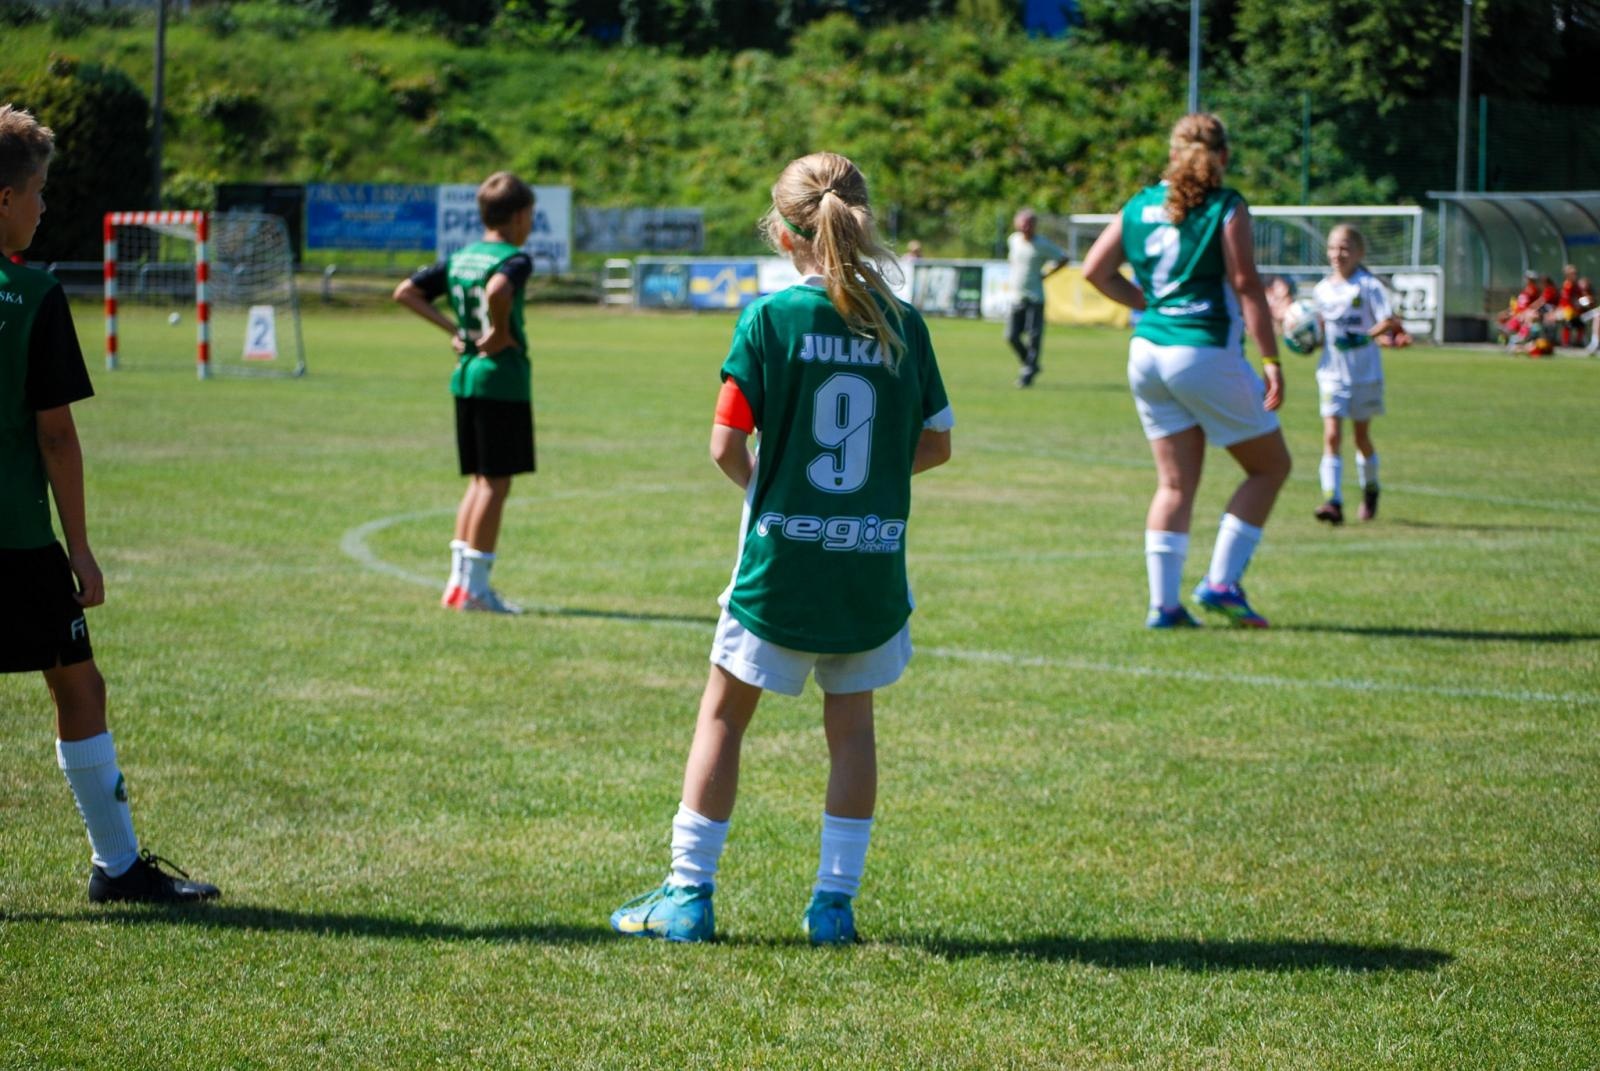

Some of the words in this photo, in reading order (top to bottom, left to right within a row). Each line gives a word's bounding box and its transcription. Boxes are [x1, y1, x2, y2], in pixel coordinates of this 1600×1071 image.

[253, 316, 270, 349] 2
[800, 333, 893, 365] JULKA
[807, 372, 876, 493] 9
[756, 512, 906, 551] regio
